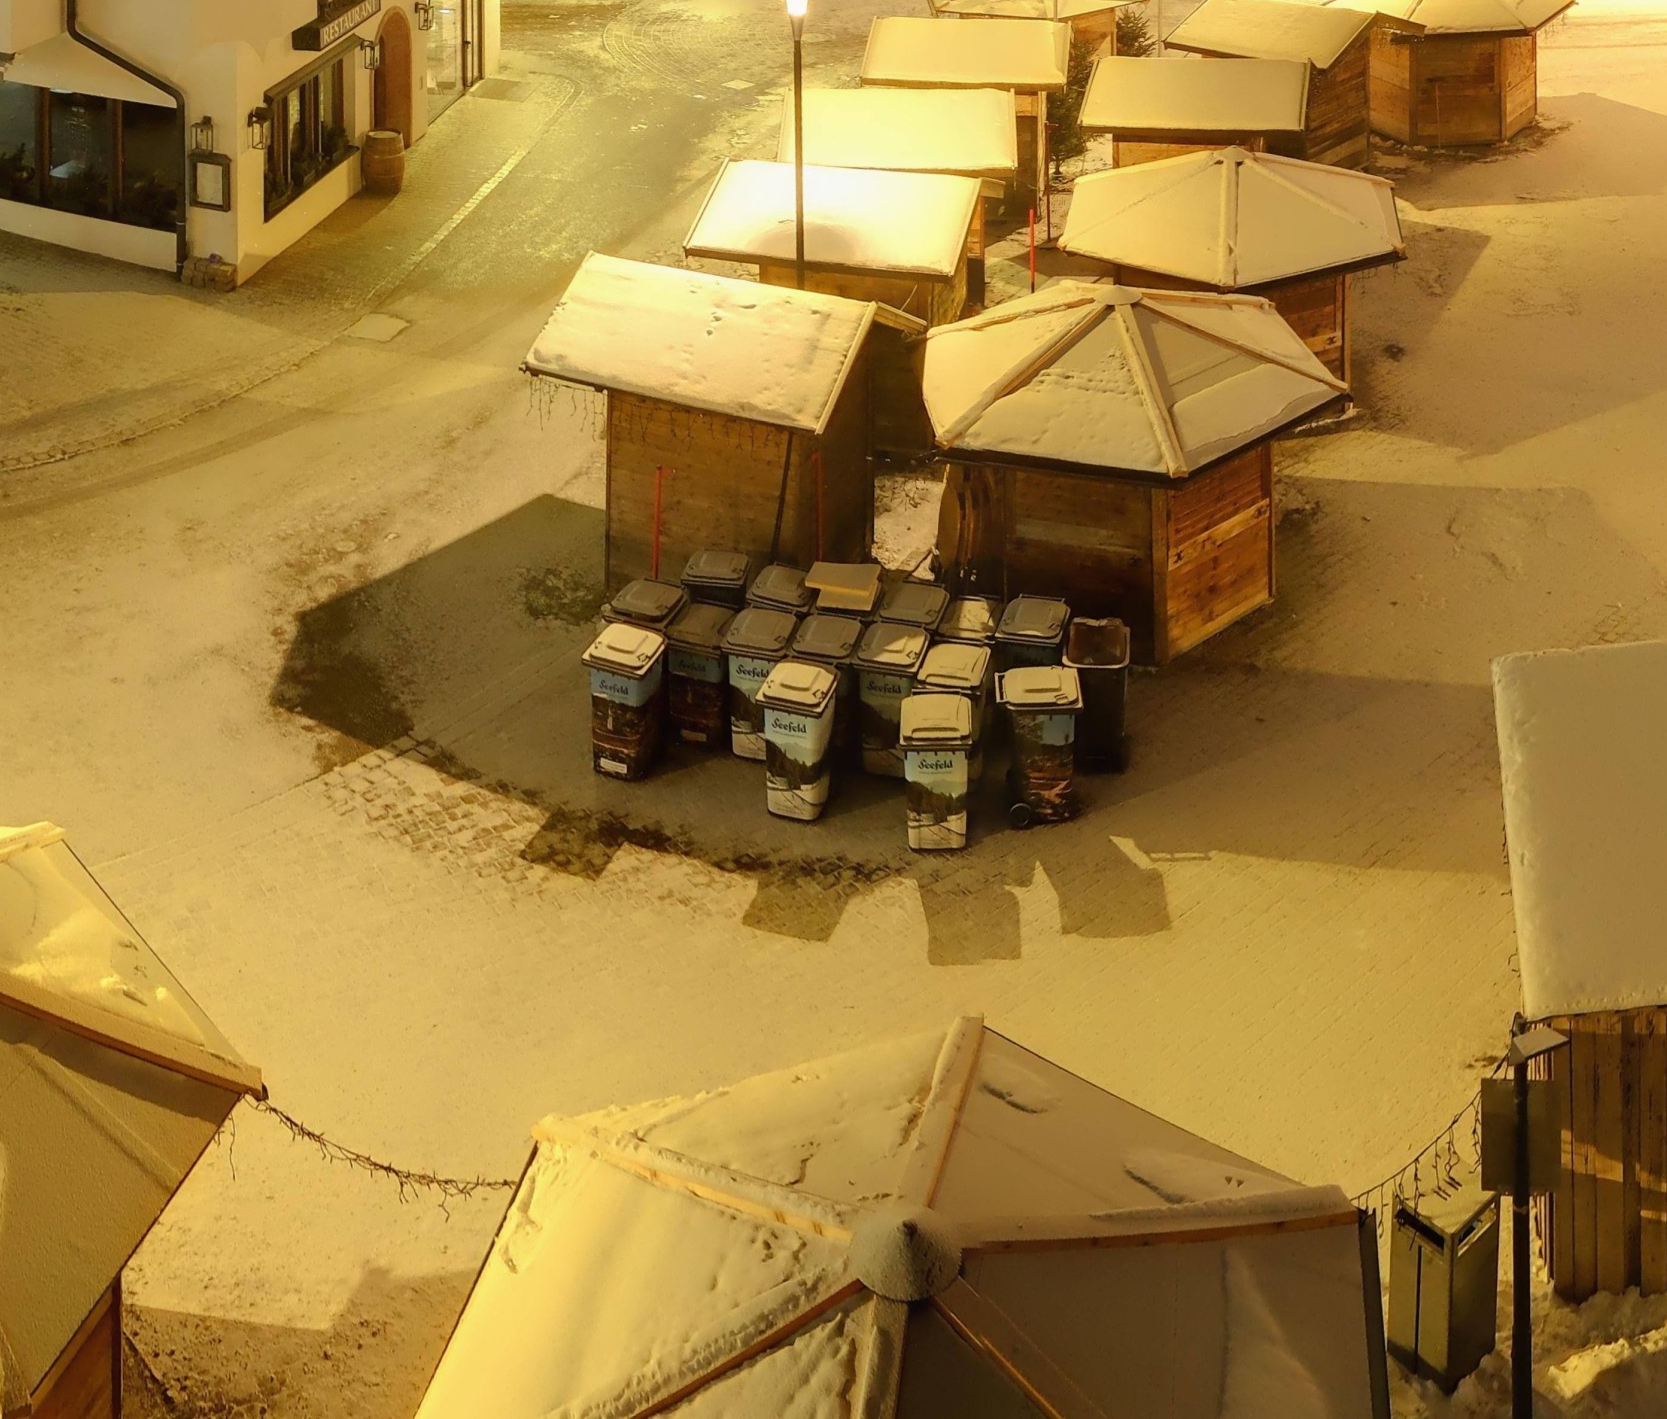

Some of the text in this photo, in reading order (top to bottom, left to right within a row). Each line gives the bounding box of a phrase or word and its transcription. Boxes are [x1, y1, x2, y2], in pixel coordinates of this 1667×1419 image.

[598, 679, 630, 696] Seefeld
[866, 680, 902, 696] Seefeld
[771, 717, 807, 735] Seefeld
[917, 758, 954, 772] Seefeld
